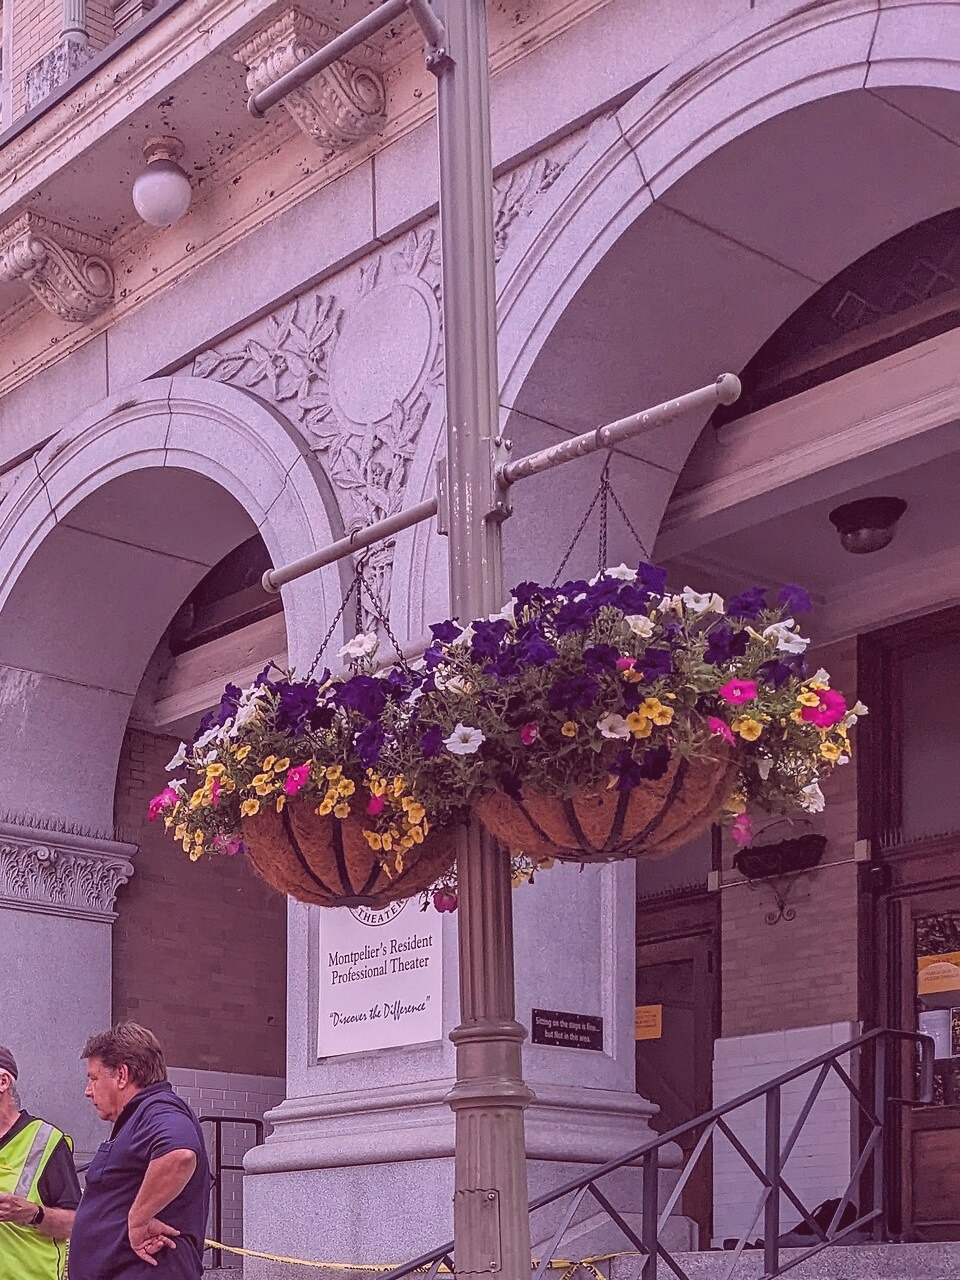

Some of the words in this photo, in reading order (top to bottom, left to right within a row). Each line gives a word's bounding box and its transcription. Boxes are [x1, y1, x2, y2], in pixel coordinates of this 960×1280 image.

[328, 942, 387, 967] Montpelier's
[389, 934, 433, 955] Resident
[331, 960, 387, 985] Professional
[390, 956, 430, 973] Theater
[369, 1004, 381, 1020] the
